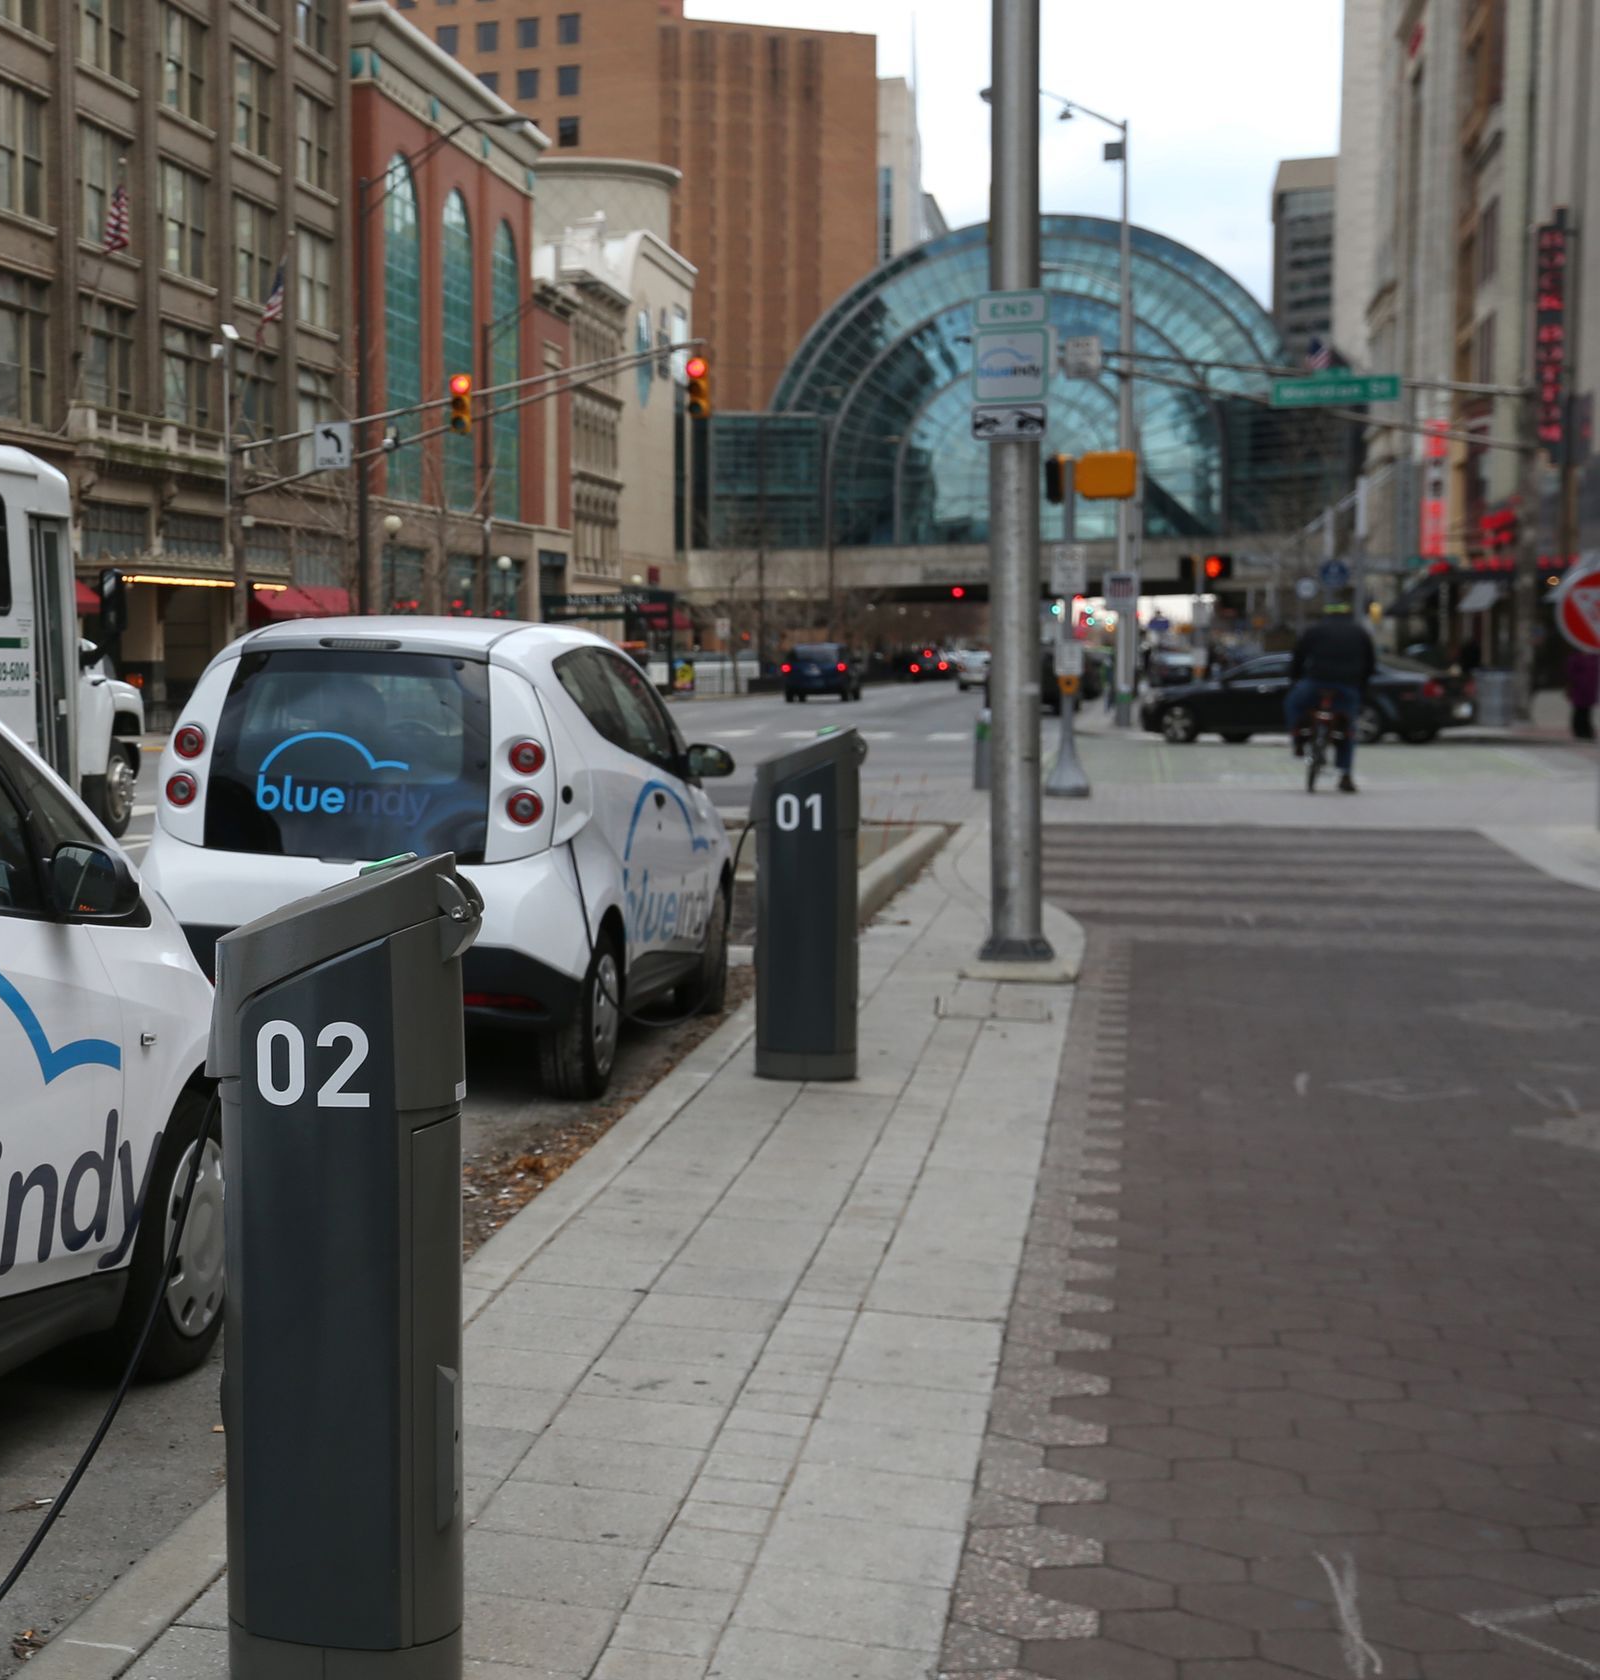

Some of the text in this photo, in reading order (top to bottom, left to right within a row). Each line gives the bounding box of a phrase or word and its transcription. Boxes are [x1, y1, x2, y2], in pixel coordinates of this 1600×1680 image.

[990, 302, 1032, 318] END
[977, 363, 1041, 379] blueindy
[1280, 383, 1361, 400] Meridian
[319, 456, 345, 466] ONLY
[256, 774, 431, 825] blueindy
[776, 793, 823, 831] 01
[257, 1019, 371, 1108] 02
